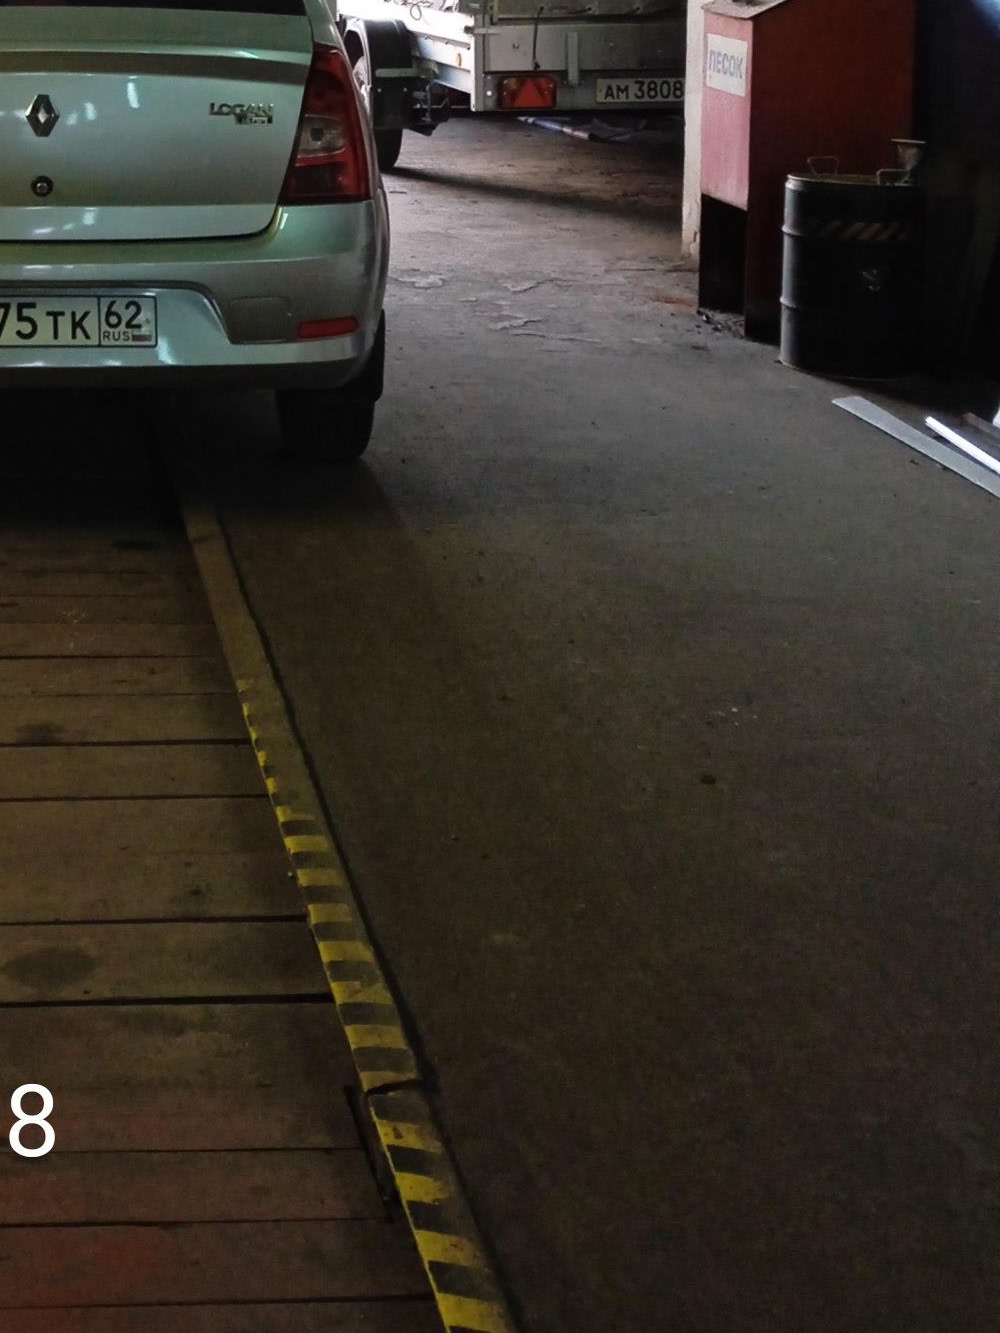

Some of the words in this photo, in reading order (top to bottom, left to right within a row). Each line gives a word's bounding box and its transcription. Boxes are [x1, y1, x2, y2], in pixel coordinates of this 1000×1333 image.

[708, 50, 743, 79] ПЕСОК
[210, 102, 274, 117] LOGAN
[105, 300, 142, 329] 62
[102, 331, 130, 342] RUS
